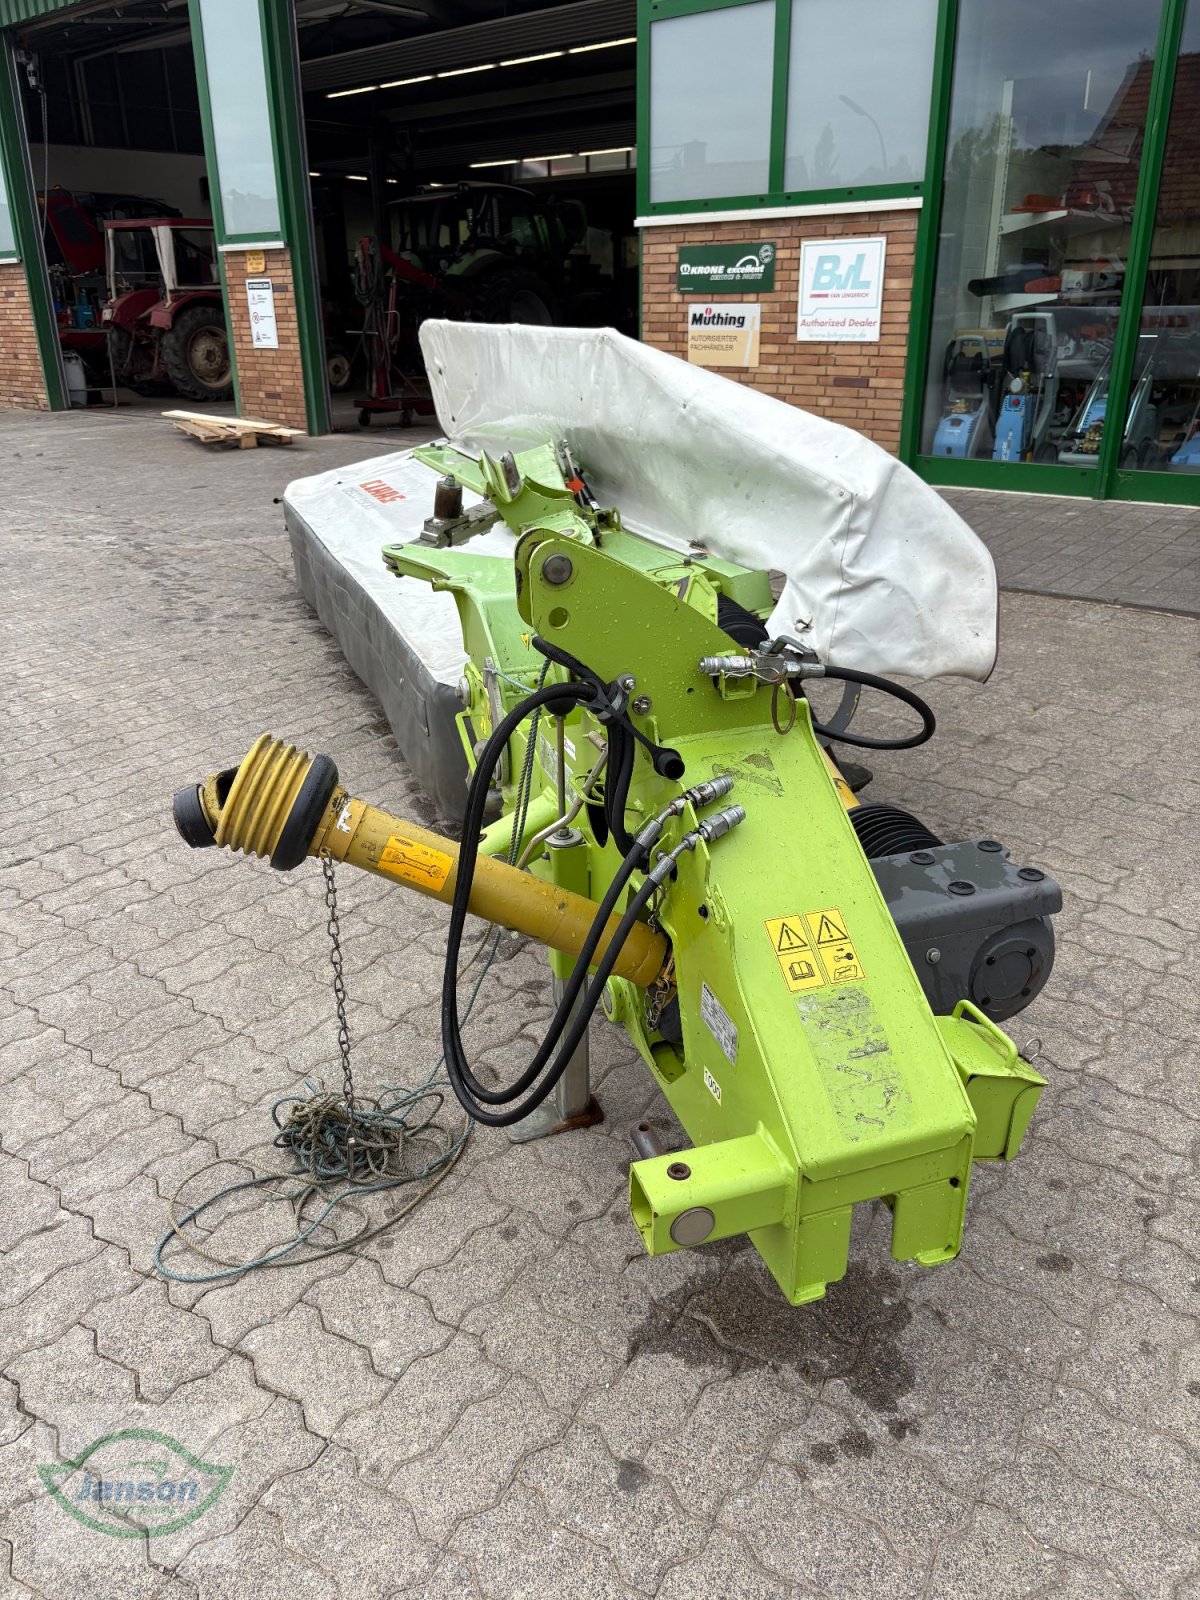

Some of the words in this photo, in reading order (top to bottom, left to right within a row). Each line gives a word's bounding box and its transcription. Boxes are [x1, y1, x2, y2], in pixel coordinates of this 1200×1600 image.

[690, 265, 725, 275] KRONE
[726, 264, 765, 274] excellent
[811, 253, 872, 290] BvL
[691, 307, 746, 328] Müthing
[800, 317, 847, 327] Authorized
[848, 317, 878, 327] Dealer
[690, 335, 738, 343] AUTORISIERTER
[358, 479, 407, 504] CLAAS
